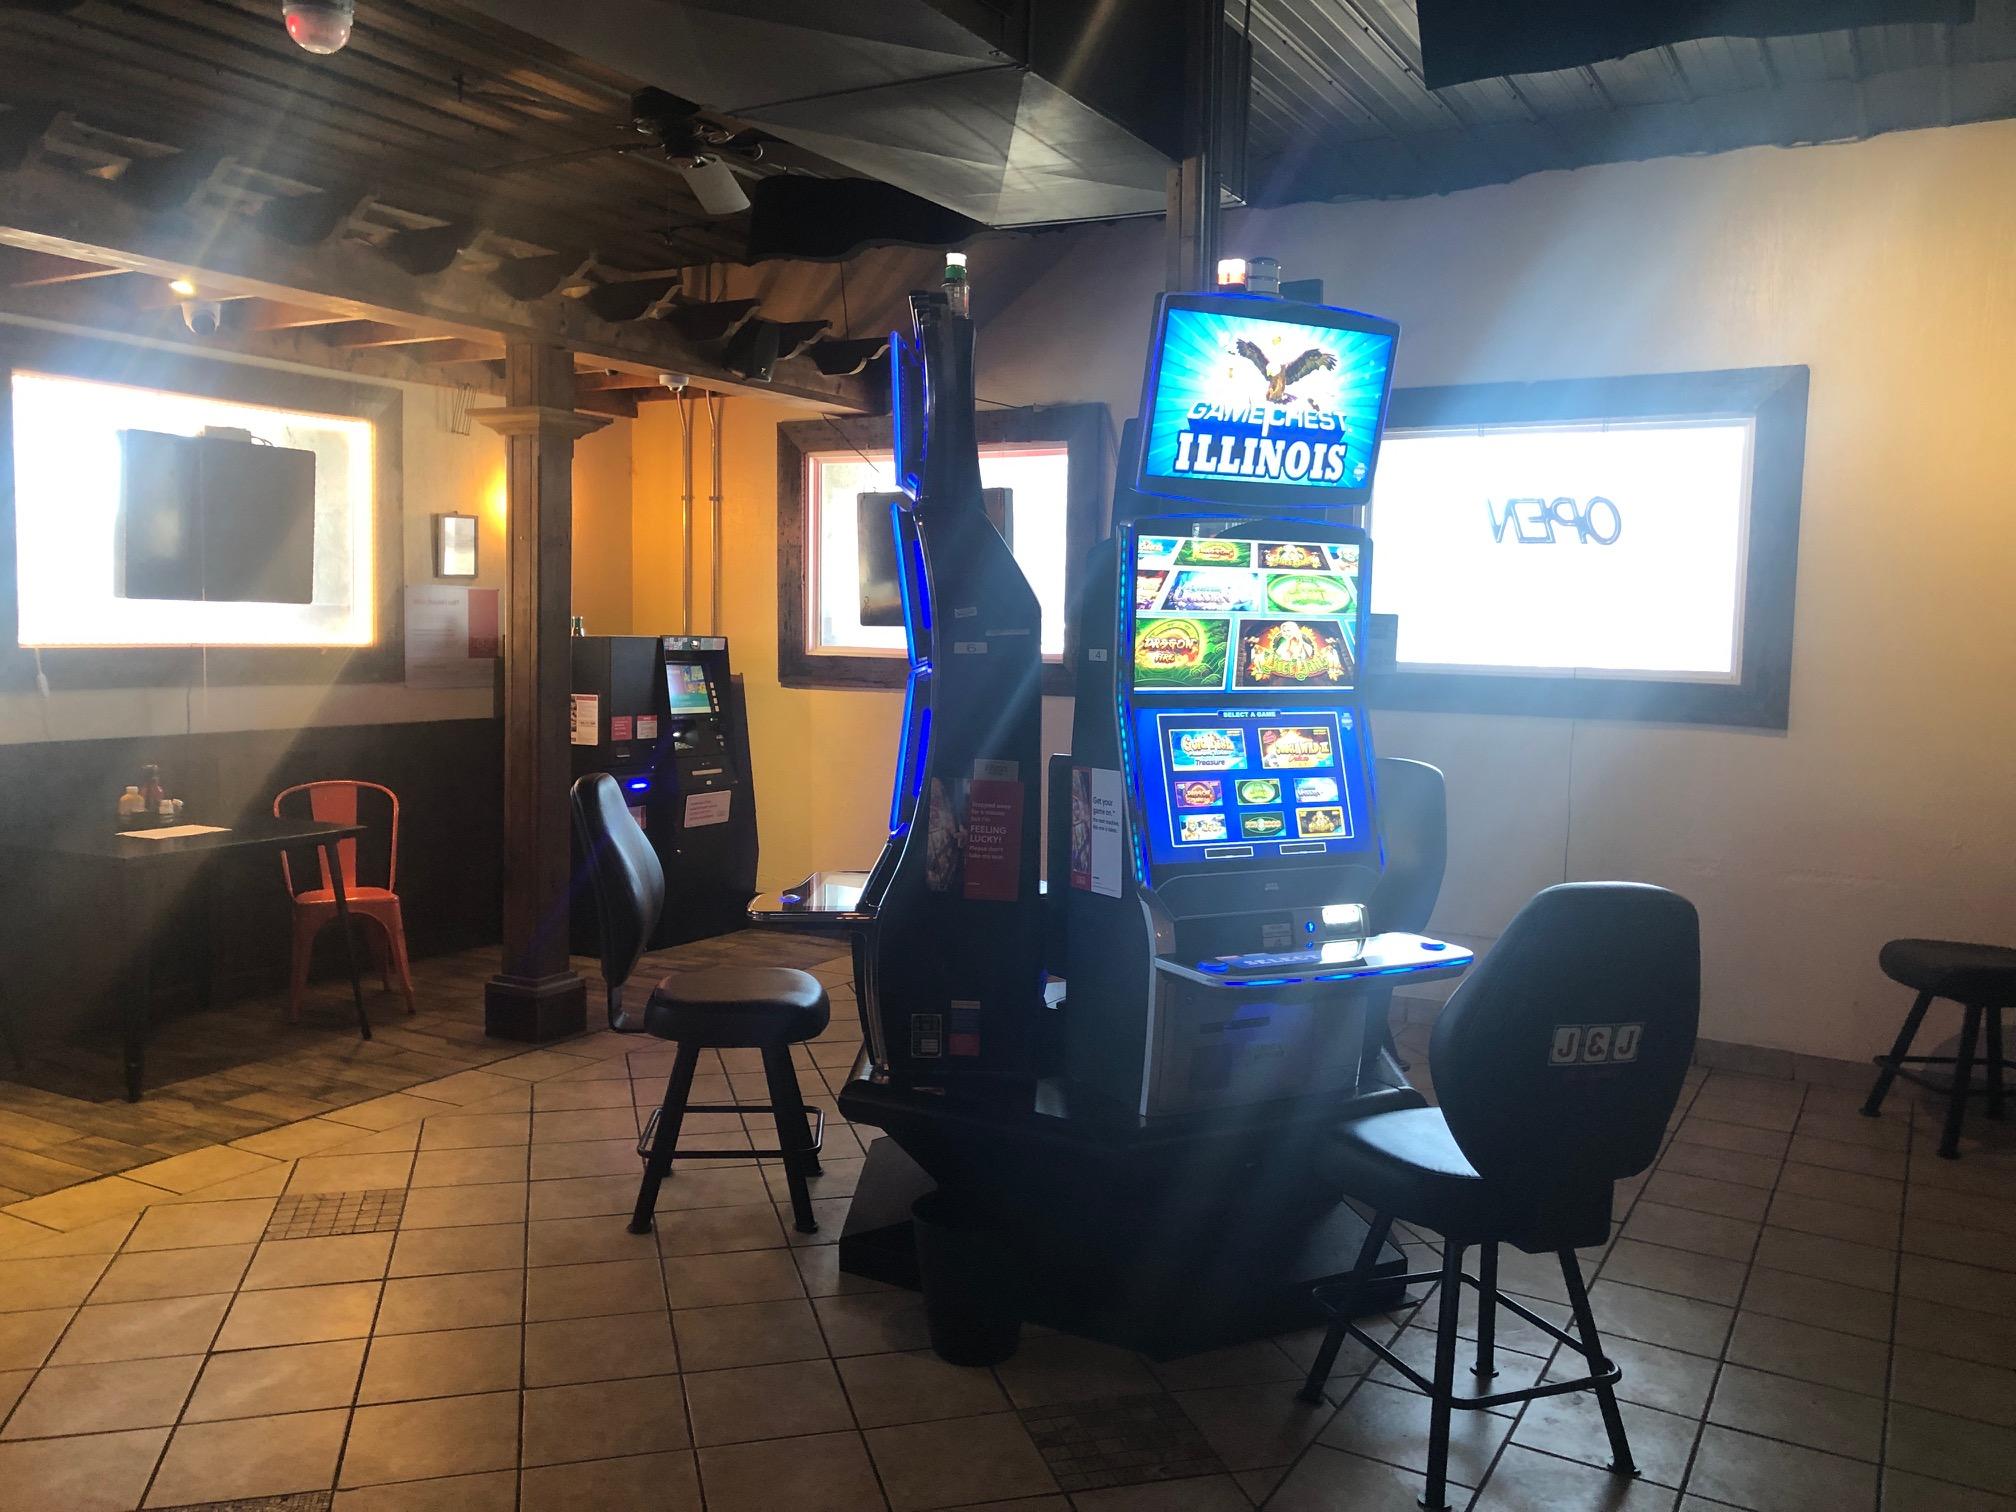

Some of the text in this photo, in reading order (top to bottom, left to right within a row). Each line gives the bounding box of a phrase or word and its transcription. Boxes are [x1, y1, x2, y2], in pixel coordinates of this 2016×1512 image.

[1174, 431, 1347, 482] ILLINOIS
[1195, 759, 1226, 767] Treasure
[970, 824, 1008, 835] FEELING
[1554, 1027, 1639, 1060] J&J
